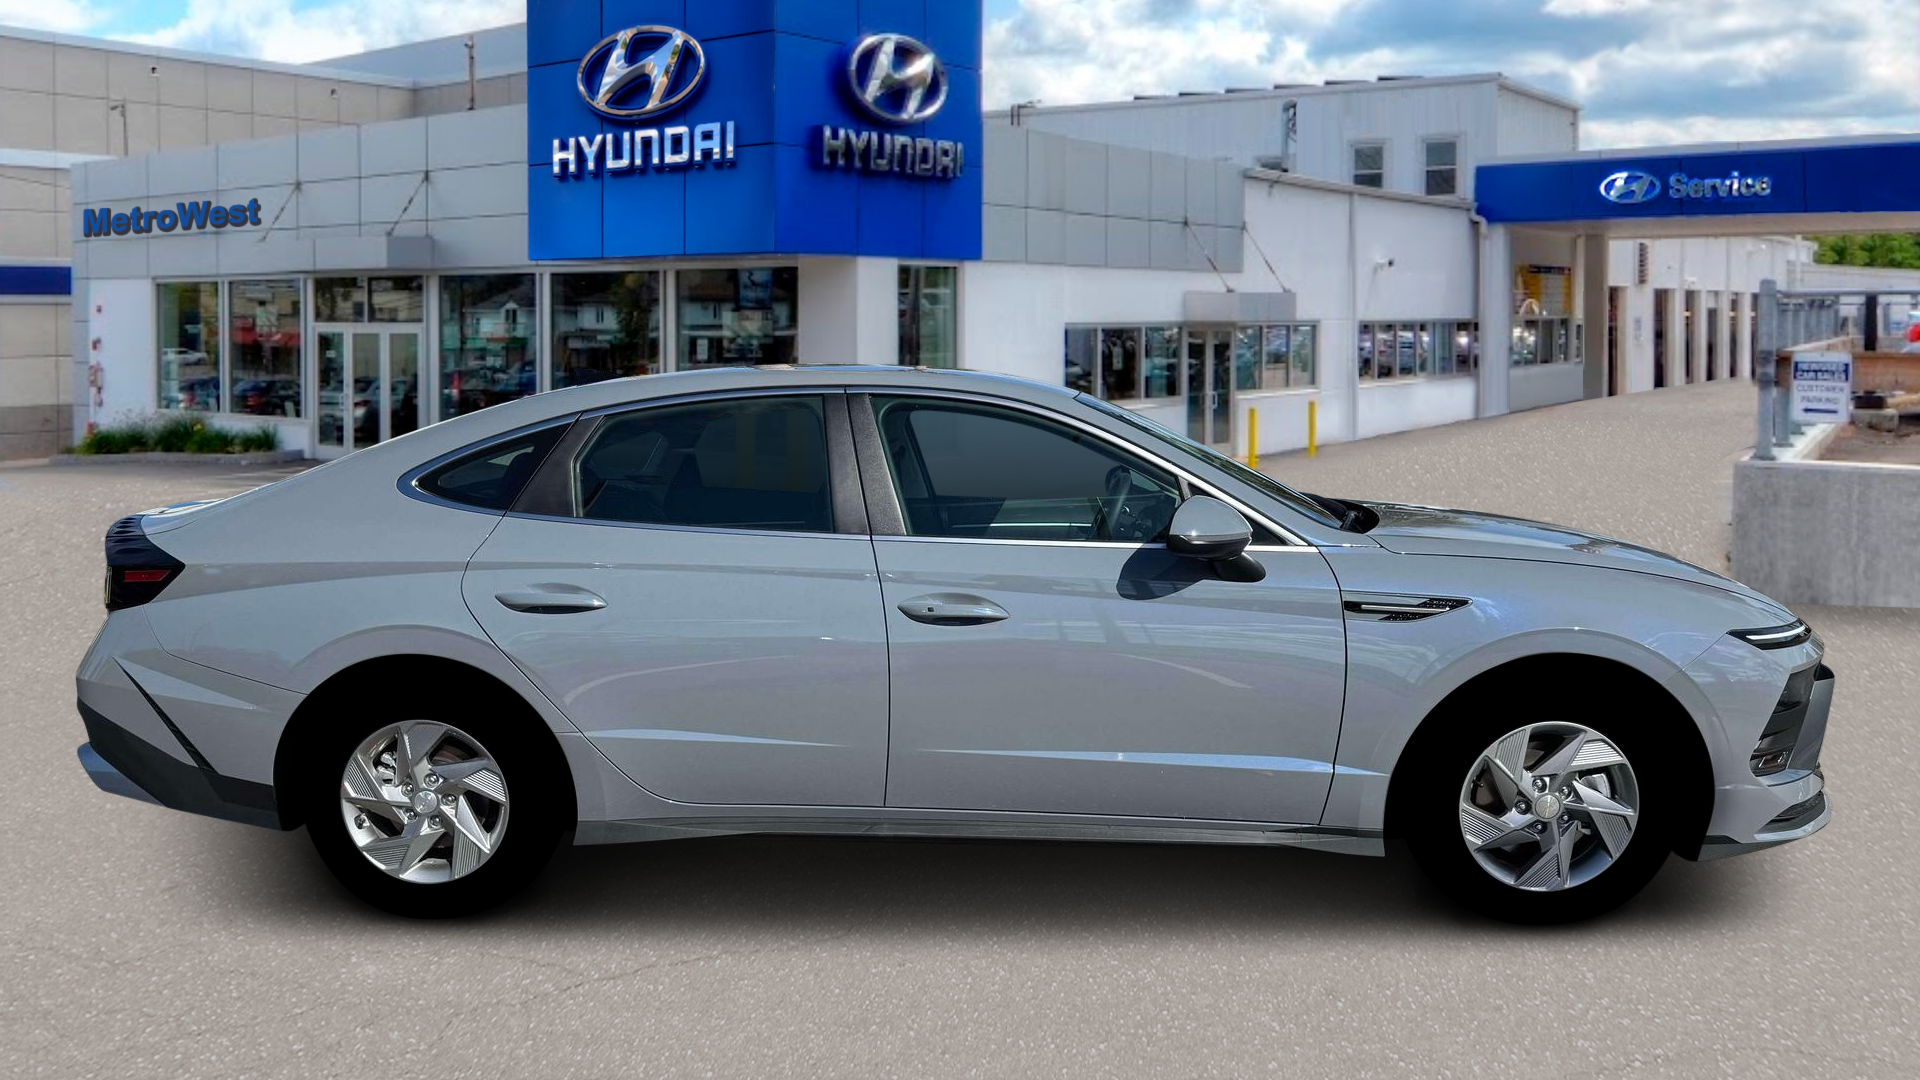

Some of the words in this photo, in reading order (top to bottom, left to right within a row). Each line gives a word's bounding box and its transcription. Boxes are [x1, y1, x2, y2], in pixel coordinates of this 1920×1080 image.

[552, 120, 736, 177] HYUNDAI
[822, 124, 964, 178] HYUNDAI
[1669, 171, 1772, 198] Service
[83, 198, 262, 237] MetroWest
